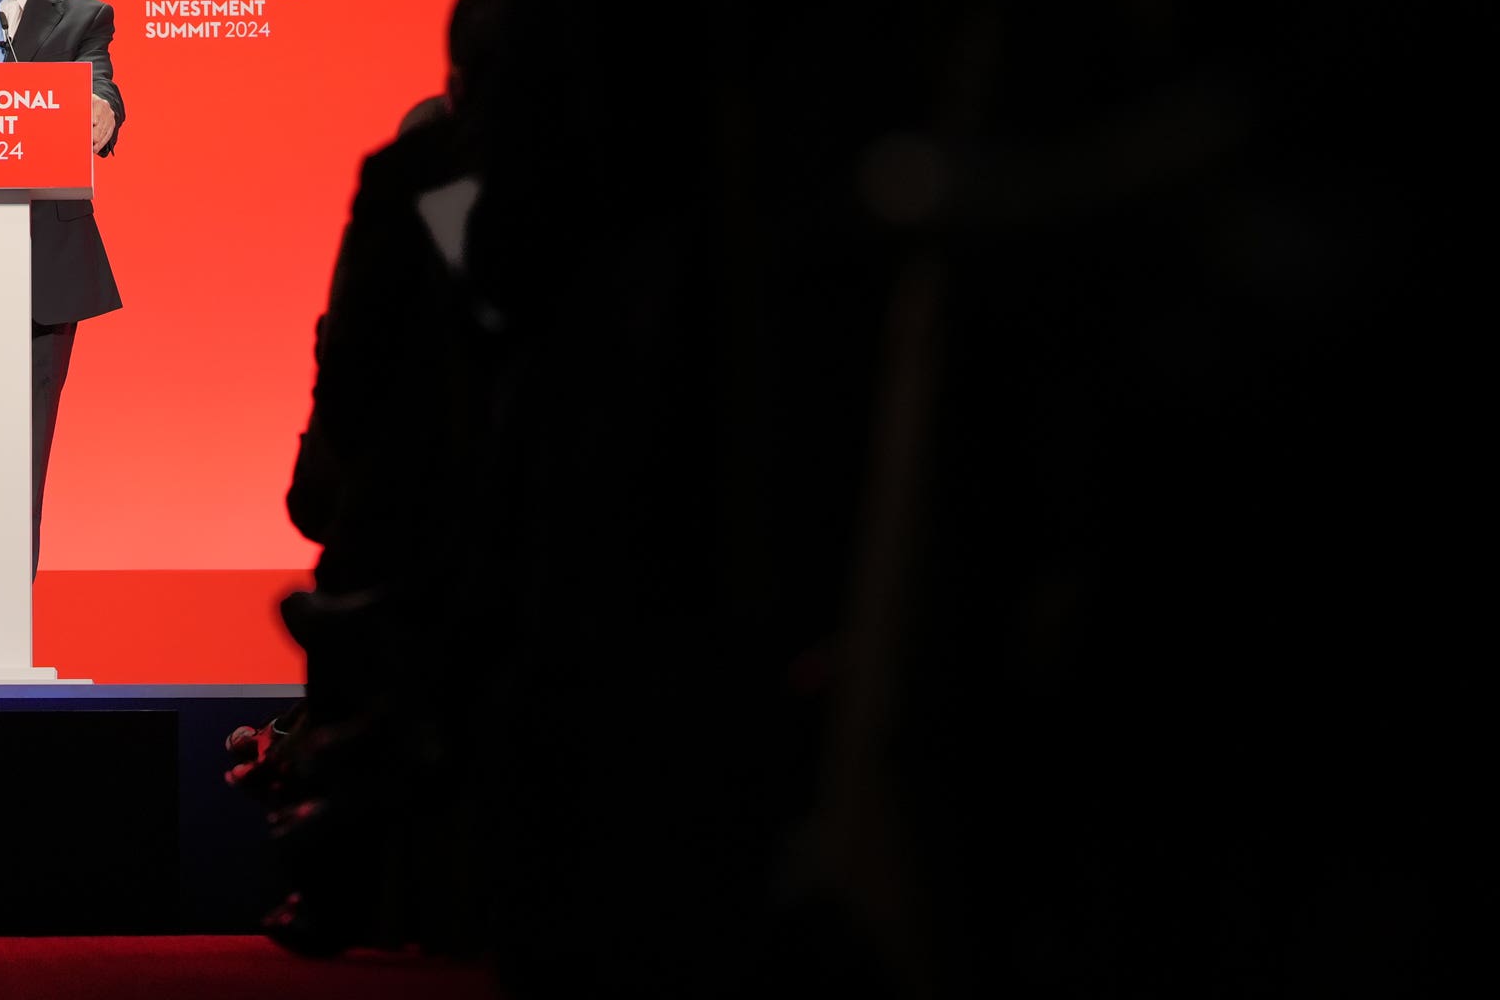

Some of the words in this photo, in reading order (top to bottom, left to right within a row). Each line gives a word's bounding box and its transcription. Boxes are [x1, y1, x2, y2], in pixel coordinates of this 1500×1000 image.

[145, 0, 266, 17] INVESTMENT
[145, 21, 222, 39] SUMMIT
[225, 21, 271, 38] 2024
